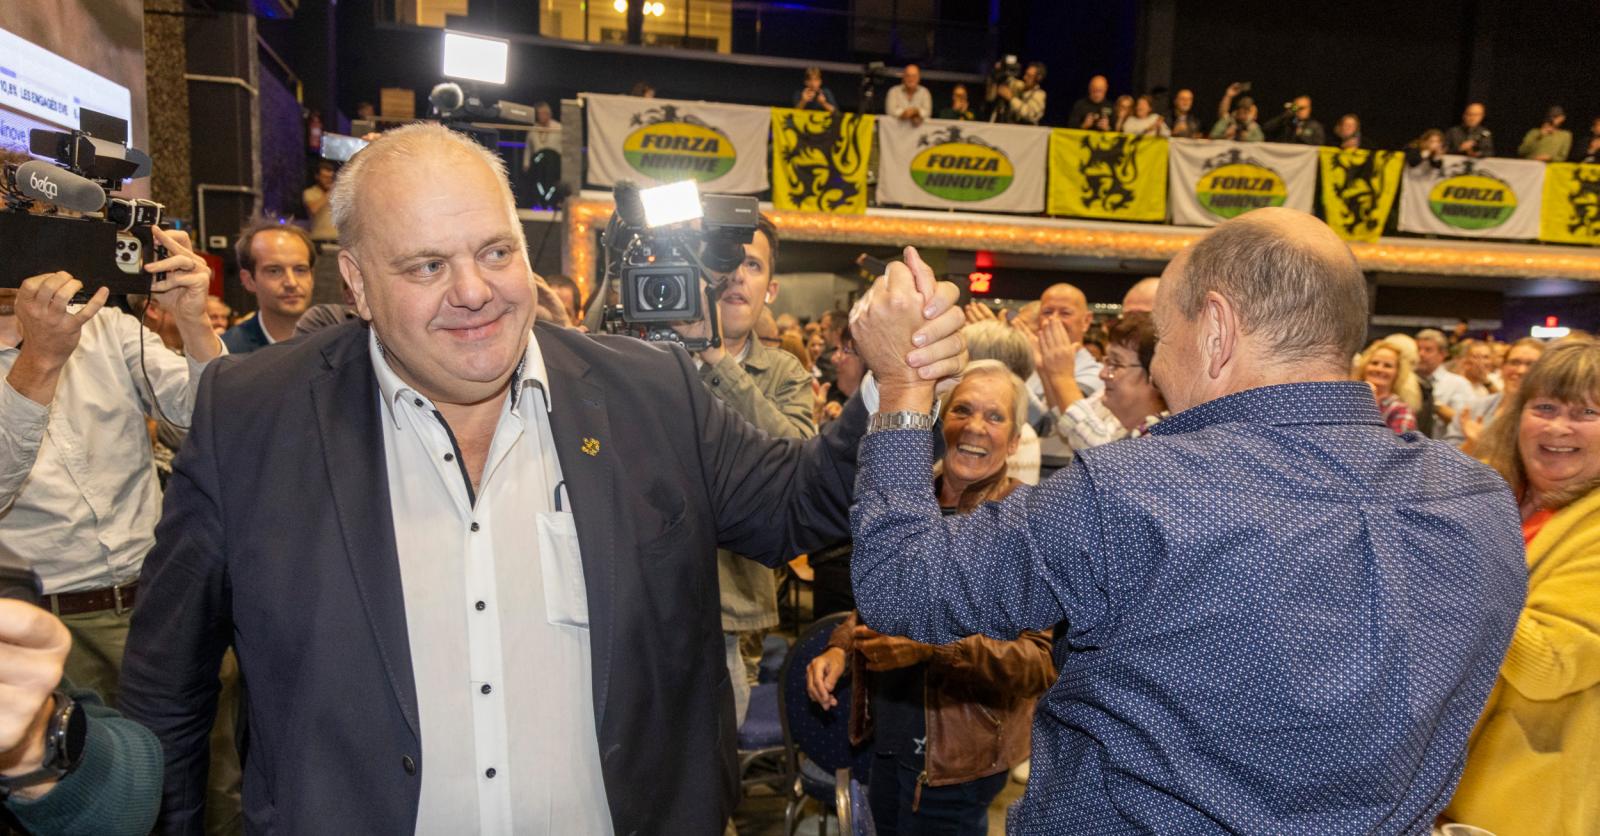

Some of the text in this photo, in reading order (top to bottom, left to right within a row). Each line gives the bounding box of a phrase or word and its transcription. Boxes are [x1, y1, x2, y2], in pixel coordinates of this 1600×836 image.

[641, 133, 719, 153] FORZA
[640, 152, 719, 173] NINOVE
[926, 153, 999, 172] FORZA
[30, 171, 58, 200] belga
[925, 172, 998, 193] NINOVE
[1209, 175, 1275, 192] FORZA
[1442, 185, 1505, 203] FORZA
